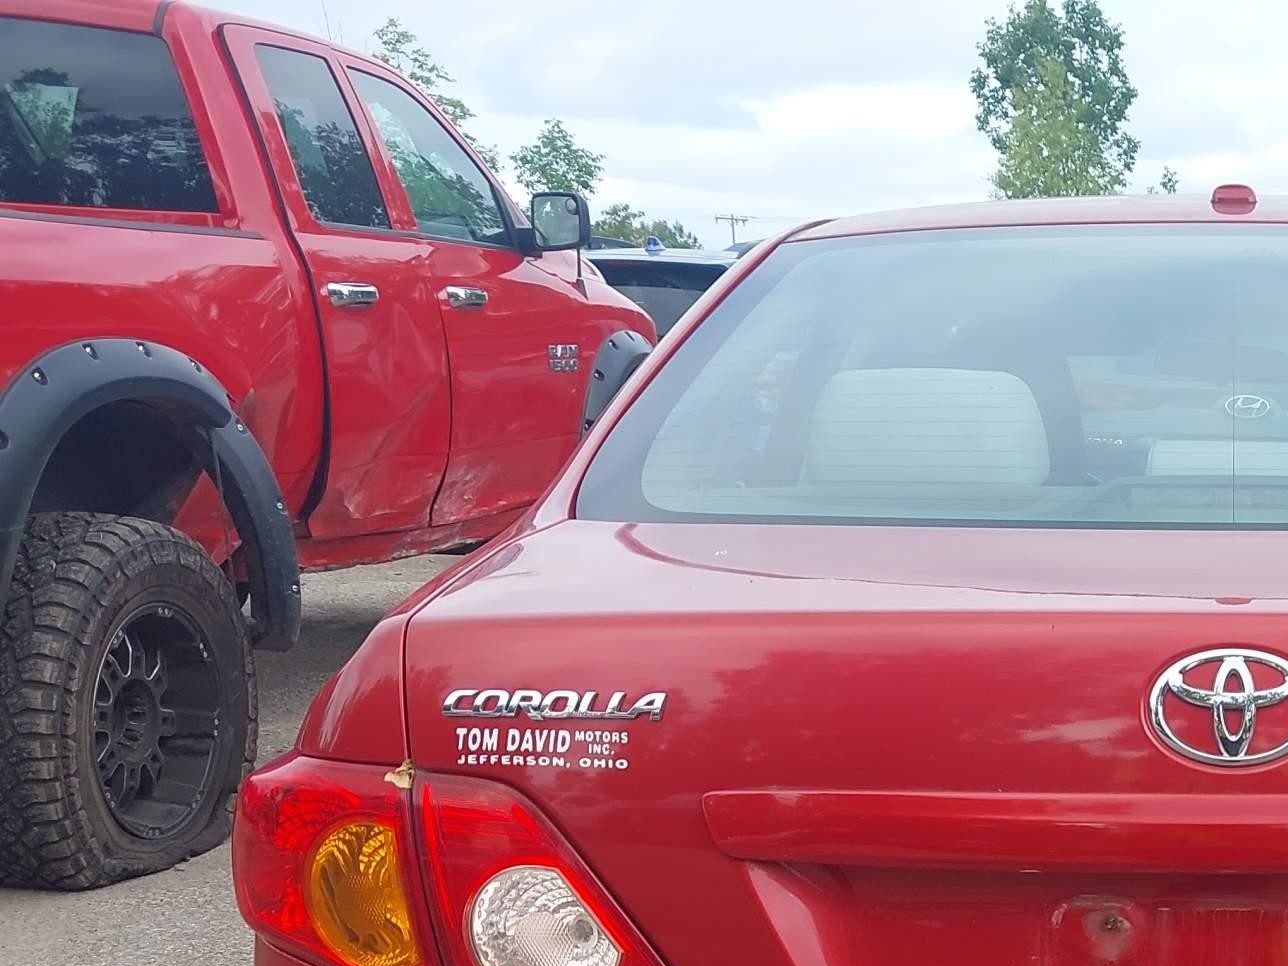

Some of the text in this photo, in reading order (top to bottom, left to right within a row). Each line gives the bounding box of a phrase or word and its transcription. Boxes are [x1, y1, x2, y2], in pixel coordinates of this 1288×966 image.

[441, 689, 667, 721] COROLLA
[456, 727, 628, 753] TOM DAVID MOTORS
[588, 743, 615, 755] INC.
[457, 754, 629, 769] JEFFERSON, OHIO
